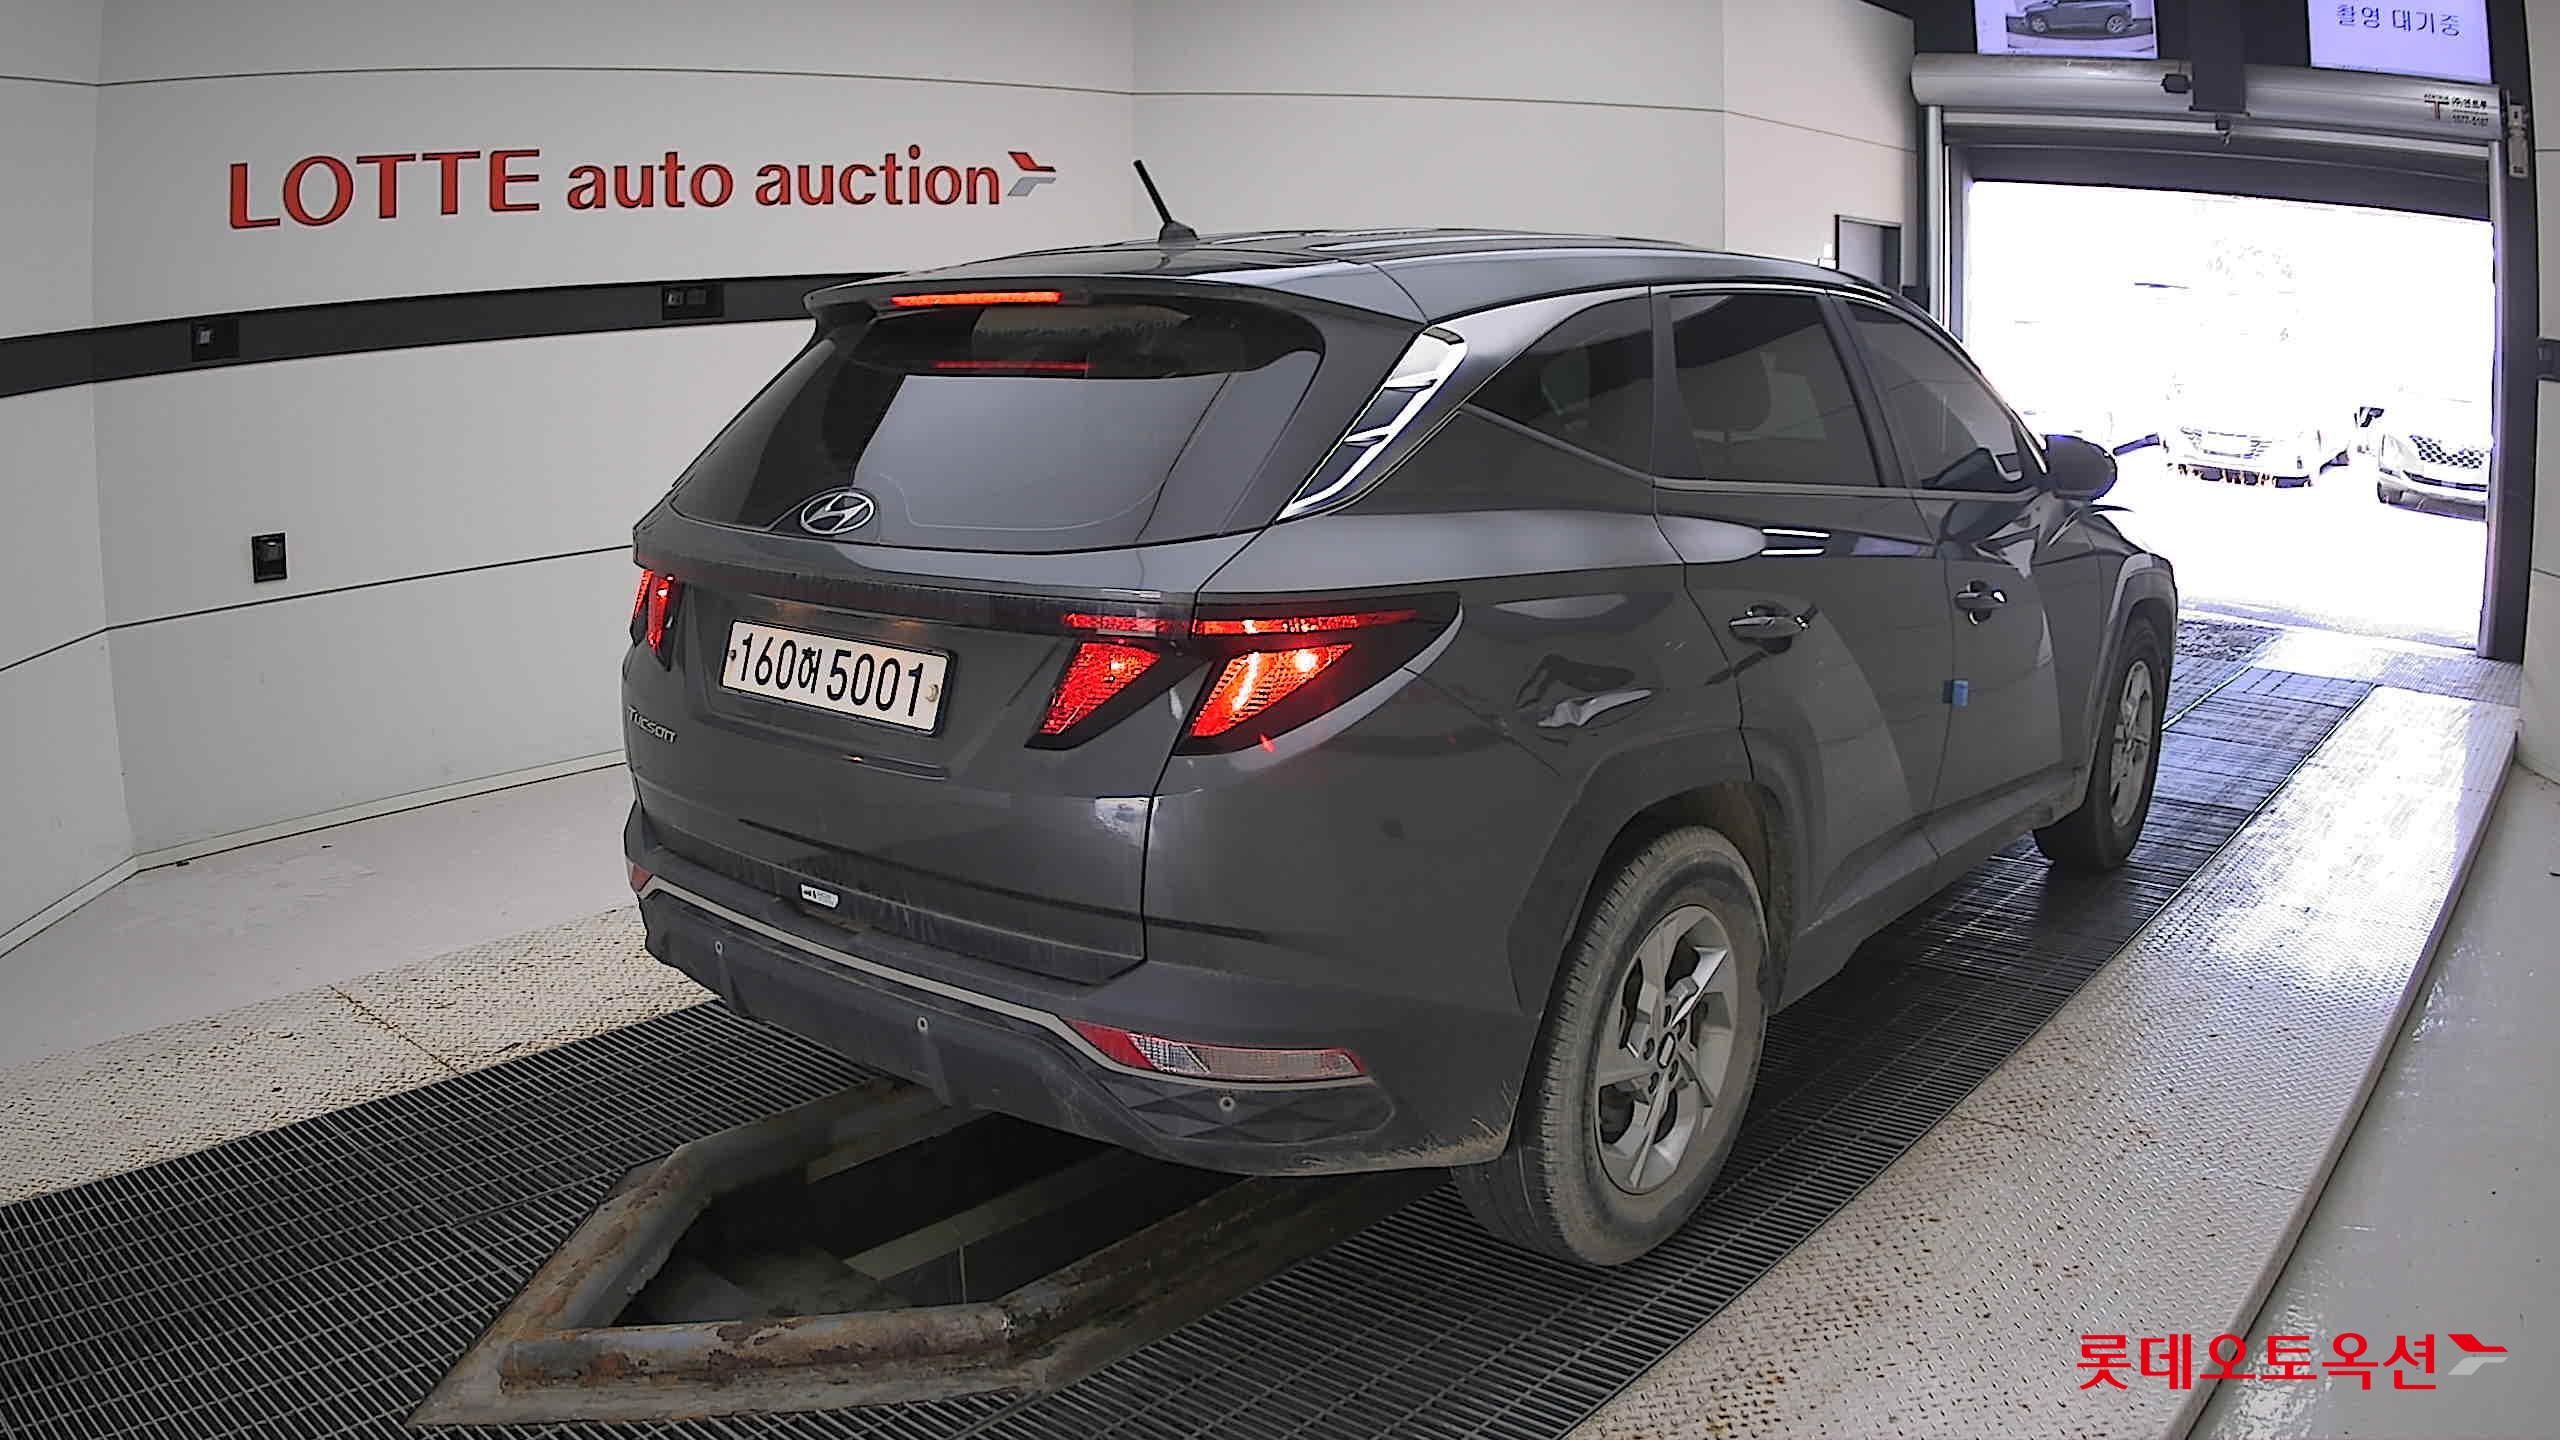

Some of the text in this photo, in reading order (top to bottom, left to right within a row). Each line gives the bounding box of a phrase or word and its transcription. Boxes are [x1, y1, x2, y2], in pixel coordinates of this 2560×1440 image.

[2337, 4, 2460, 37] 촬영 대기중
[230, 145, 1001, 229] LOTTE auto auction
